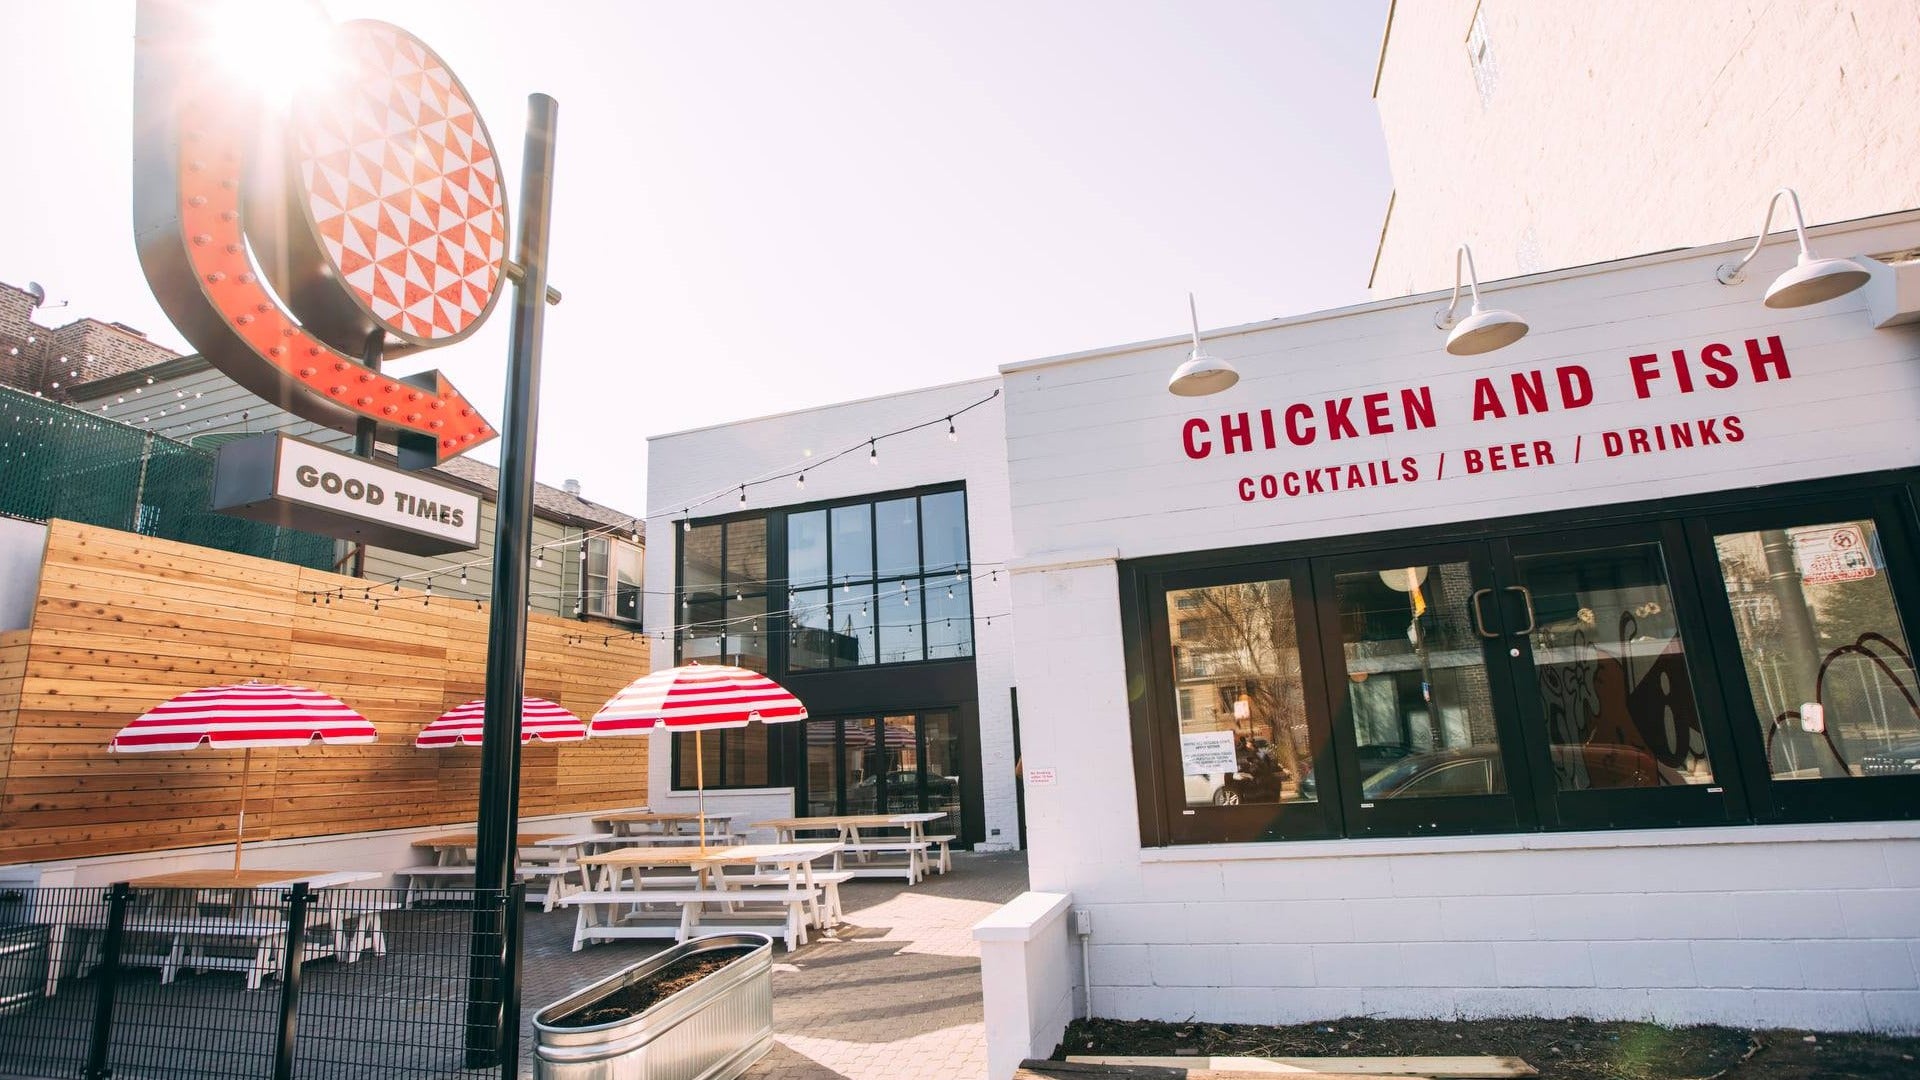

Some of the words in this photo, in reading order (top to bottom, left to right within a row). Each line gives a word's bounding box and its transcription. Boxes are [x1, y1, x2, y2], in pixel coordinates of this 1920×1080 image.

[1182, 386, 1437, 461] CHICKEN
[1472, 365, 1594, 422] AND
[1629, 335, 1792, 399] FISH
[295, 464, 385, 506] GOOD
[394, 491, 464, 528] TIMES
[1238, 456, 1420, 502] COCKTAILS
[1438, 453, 1445, 481] /
[1463, 440, 1555, 475] BEER
[1574, 437, 1582, 464] /
[1602, 415, 1745, 459] DRINKS
